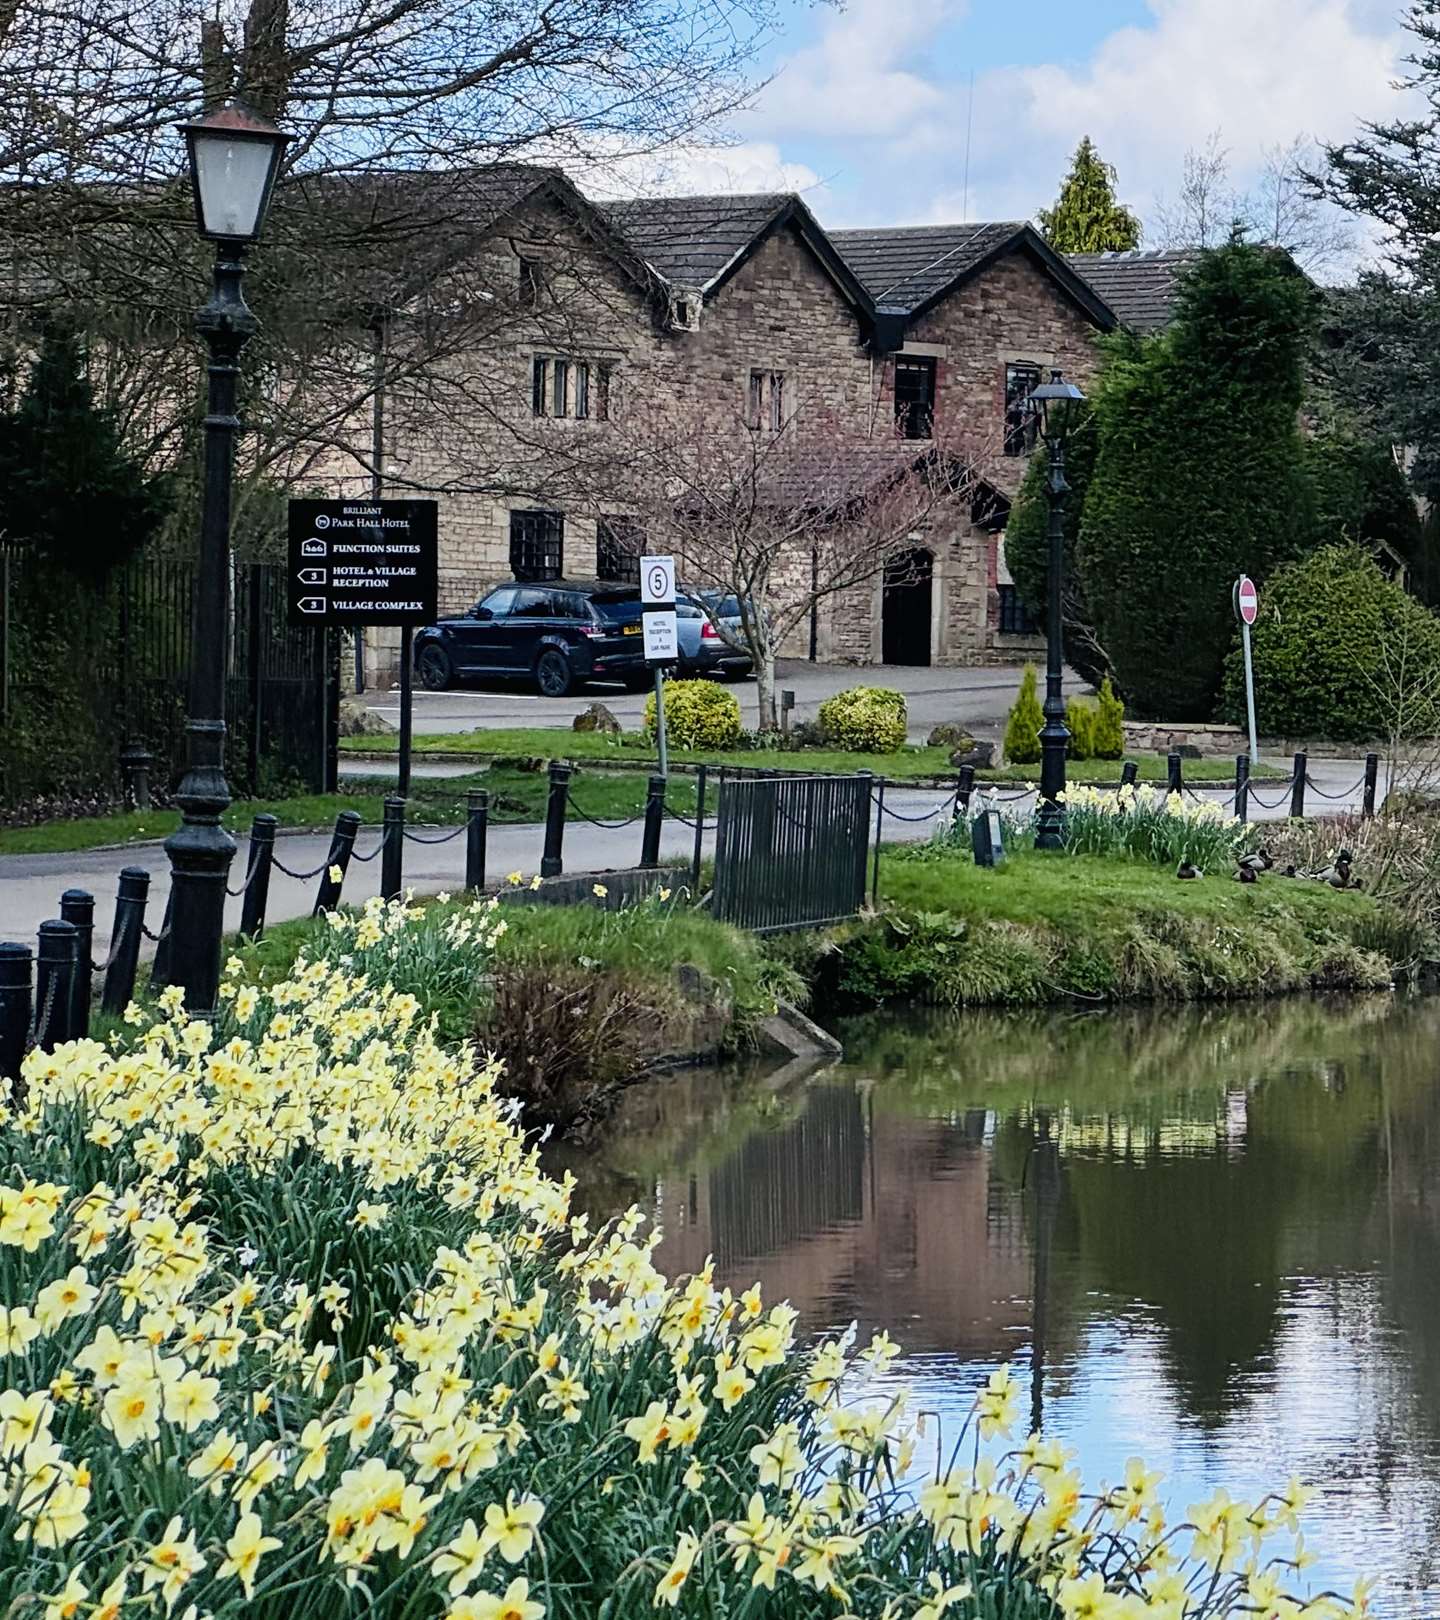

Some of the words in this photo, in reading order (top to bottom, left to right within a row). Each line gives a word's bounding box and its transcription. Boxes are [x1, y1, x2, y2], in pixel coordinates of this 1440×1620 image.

[332, 518, 354, 527] PARK
[357, 518, 380, 527] HALL
[382, 518, 410, 528] HOTEL
[333, 544, 384, 553] FUNCTION
[386, 545, 421, 553] SUITES
[333, 567, 366, 575] HOTEL
[375, 567, 416, 575] VILLAGE
[311, 572, 317, 580] 3
[332, 579, 389, 587] RECEPTION
[654, 573, 662, 590] 5
[311, 601, 317, 609] 3
[332, 601, 373, 609] VILLAGE
[375, 601, 423, 610] COMPLEX
